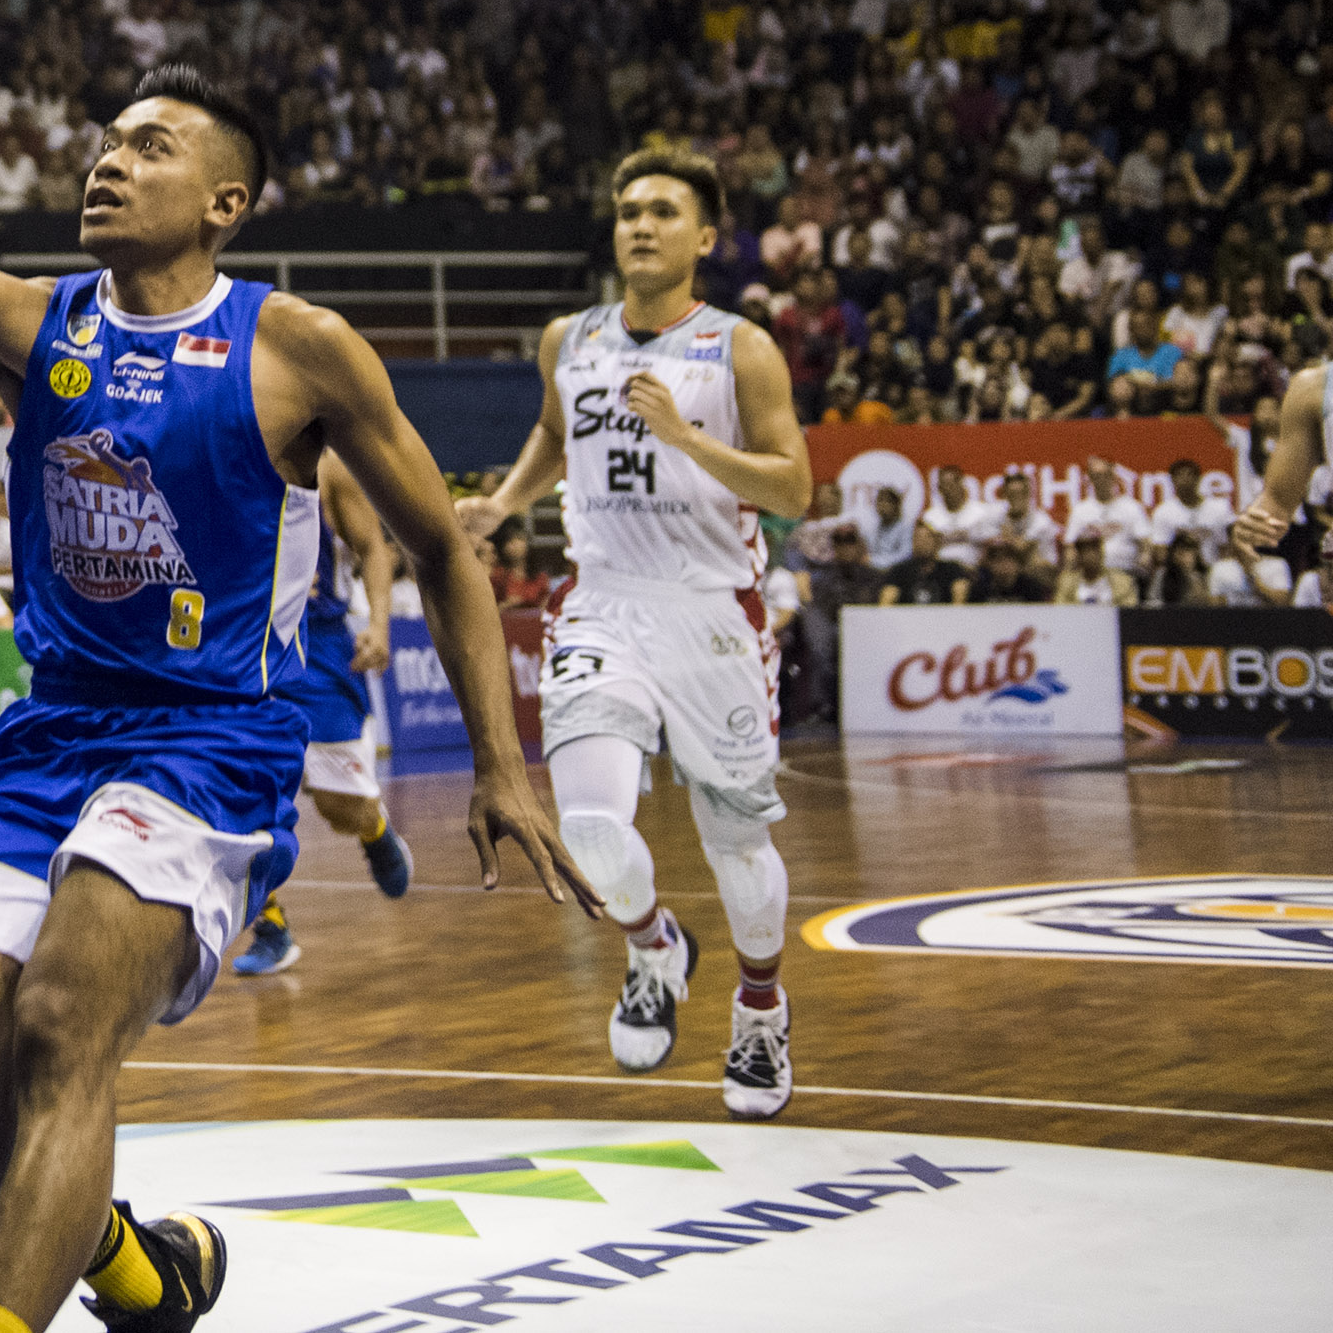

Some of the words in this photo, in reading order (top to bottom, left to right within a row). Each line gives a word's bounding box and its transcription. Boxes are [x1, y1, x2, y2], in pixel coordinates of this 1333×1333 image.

[44, 465, 173, 527] SATRIA
[608, 449, 655, 494] 24
[46, 500, 180, 555] MUDA
[53, 547, 196, 583] PERTAMINA
[166, 587, 205, 650] 8
[888, 626, 1036, 712] Club
